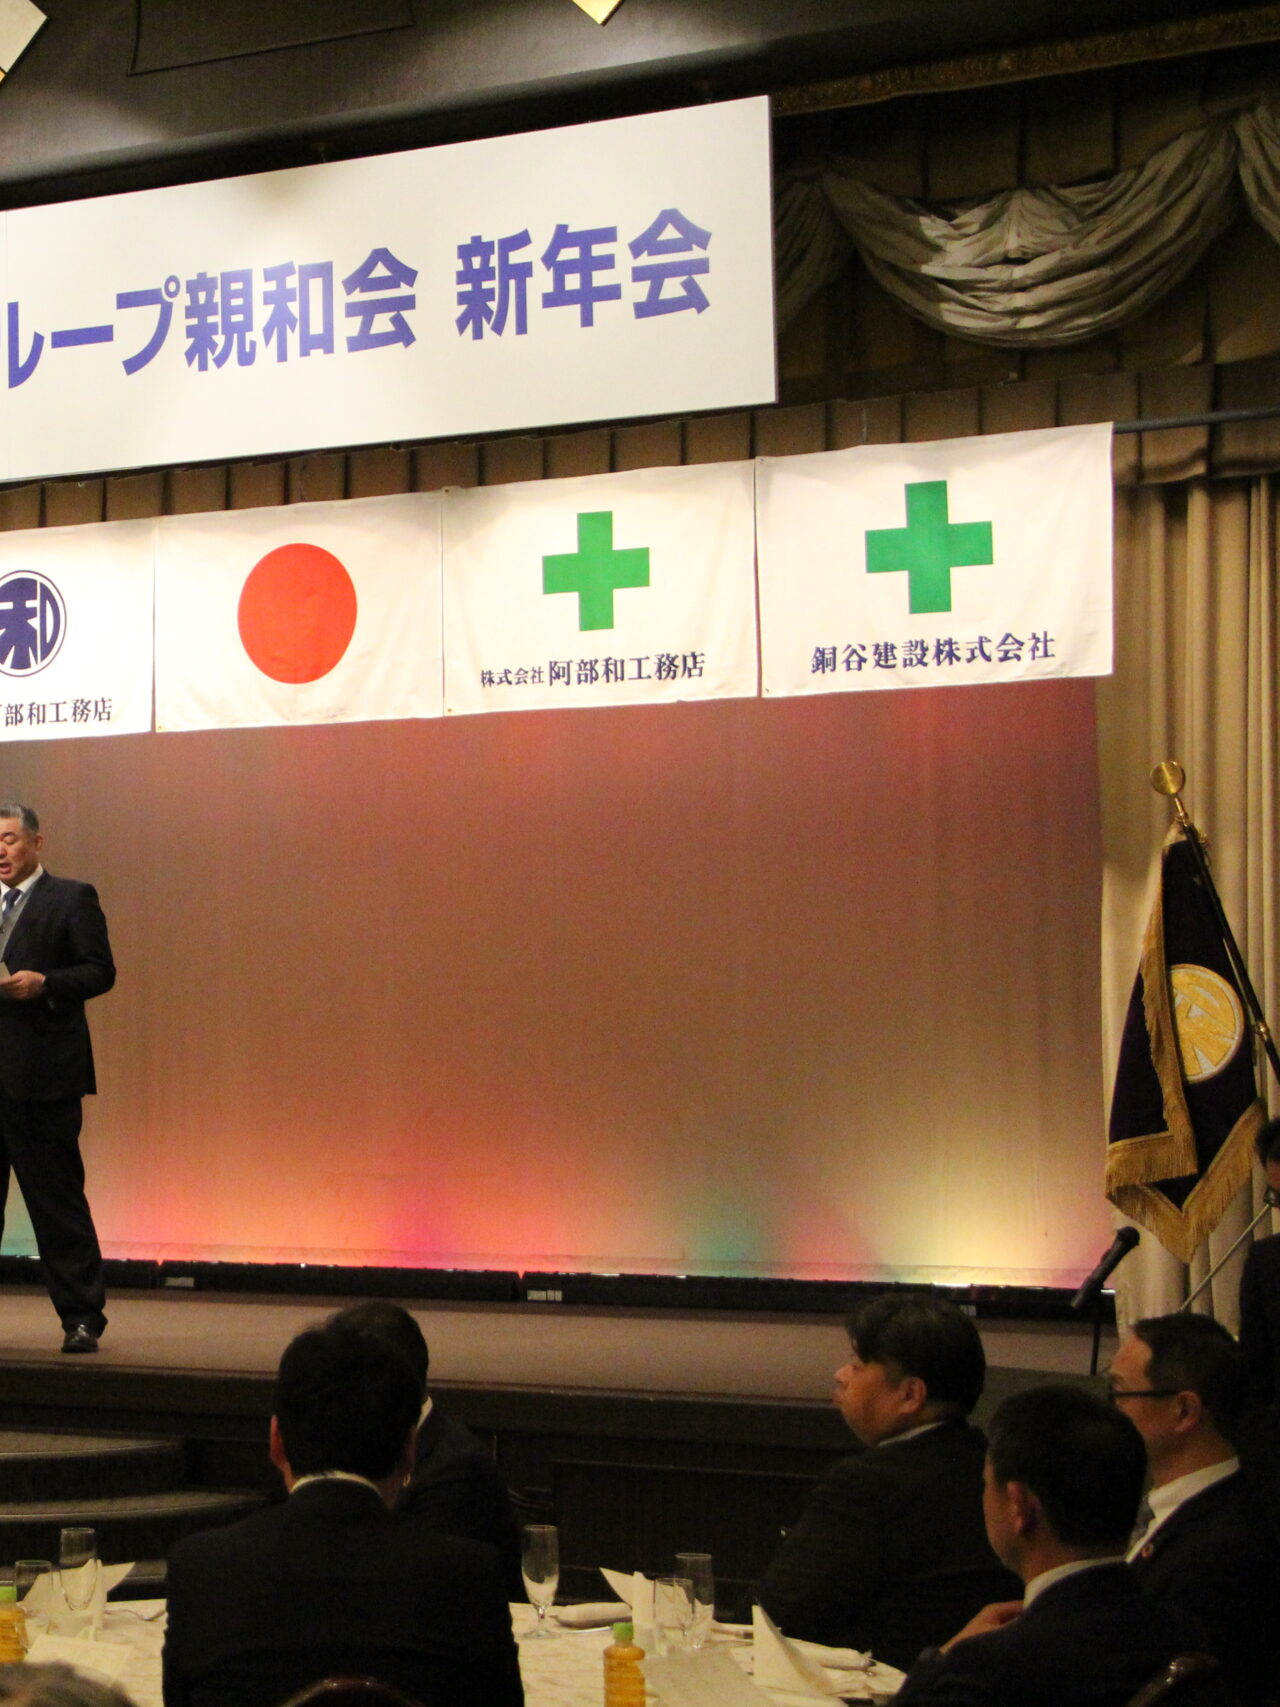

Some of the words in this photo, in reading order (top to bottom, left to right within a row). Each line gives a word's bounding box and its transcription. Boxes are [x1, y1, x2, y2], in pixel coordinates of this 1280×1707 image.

[456, 208, 712, 341] 新年会
[811, 631, 1056, 674] 銅谷建設株式会社
